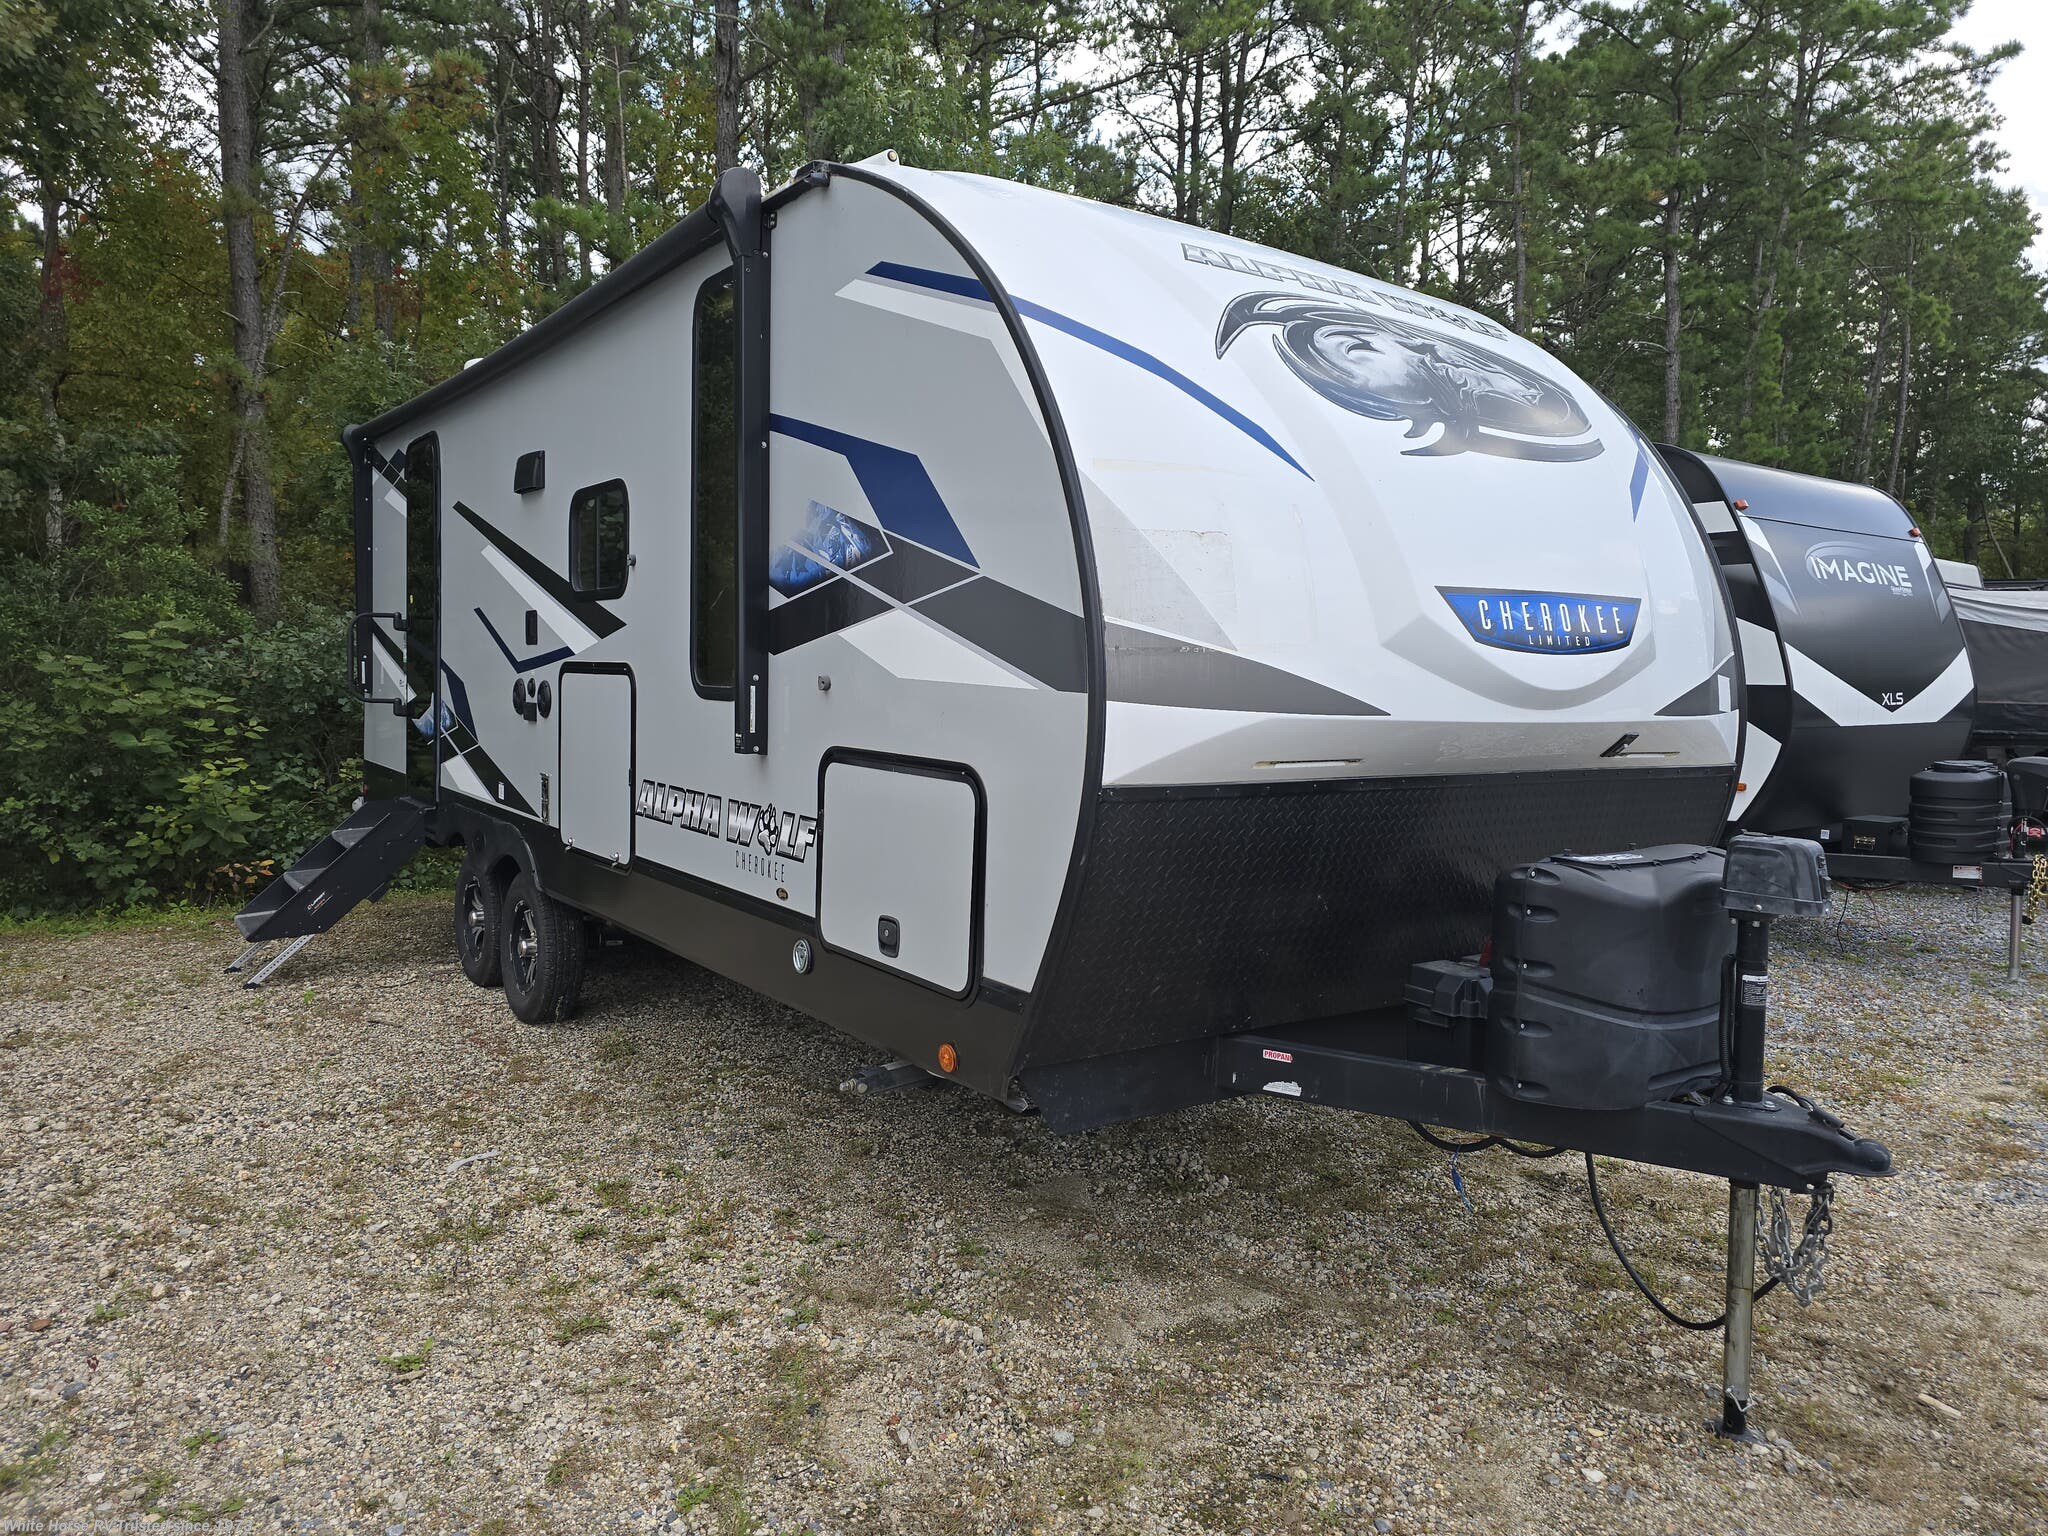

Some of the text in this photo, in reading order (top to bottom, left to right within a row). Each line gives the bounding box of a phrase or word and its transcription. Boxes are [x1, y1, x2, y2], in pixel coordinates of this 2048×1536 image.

[1181, 242, 1381, 305] ALPHA
[1809, 556, 1912, 588] IMAGINE
[1478, 600, 1624, 634] CHEROKEE
[1528, 634, 1592, 647] LIMITED
[1881, 692, 1904, 706] XLS
[635, 779, 722, 838] ALPHA
[735, 849, 786, 883] CHEROKEE
